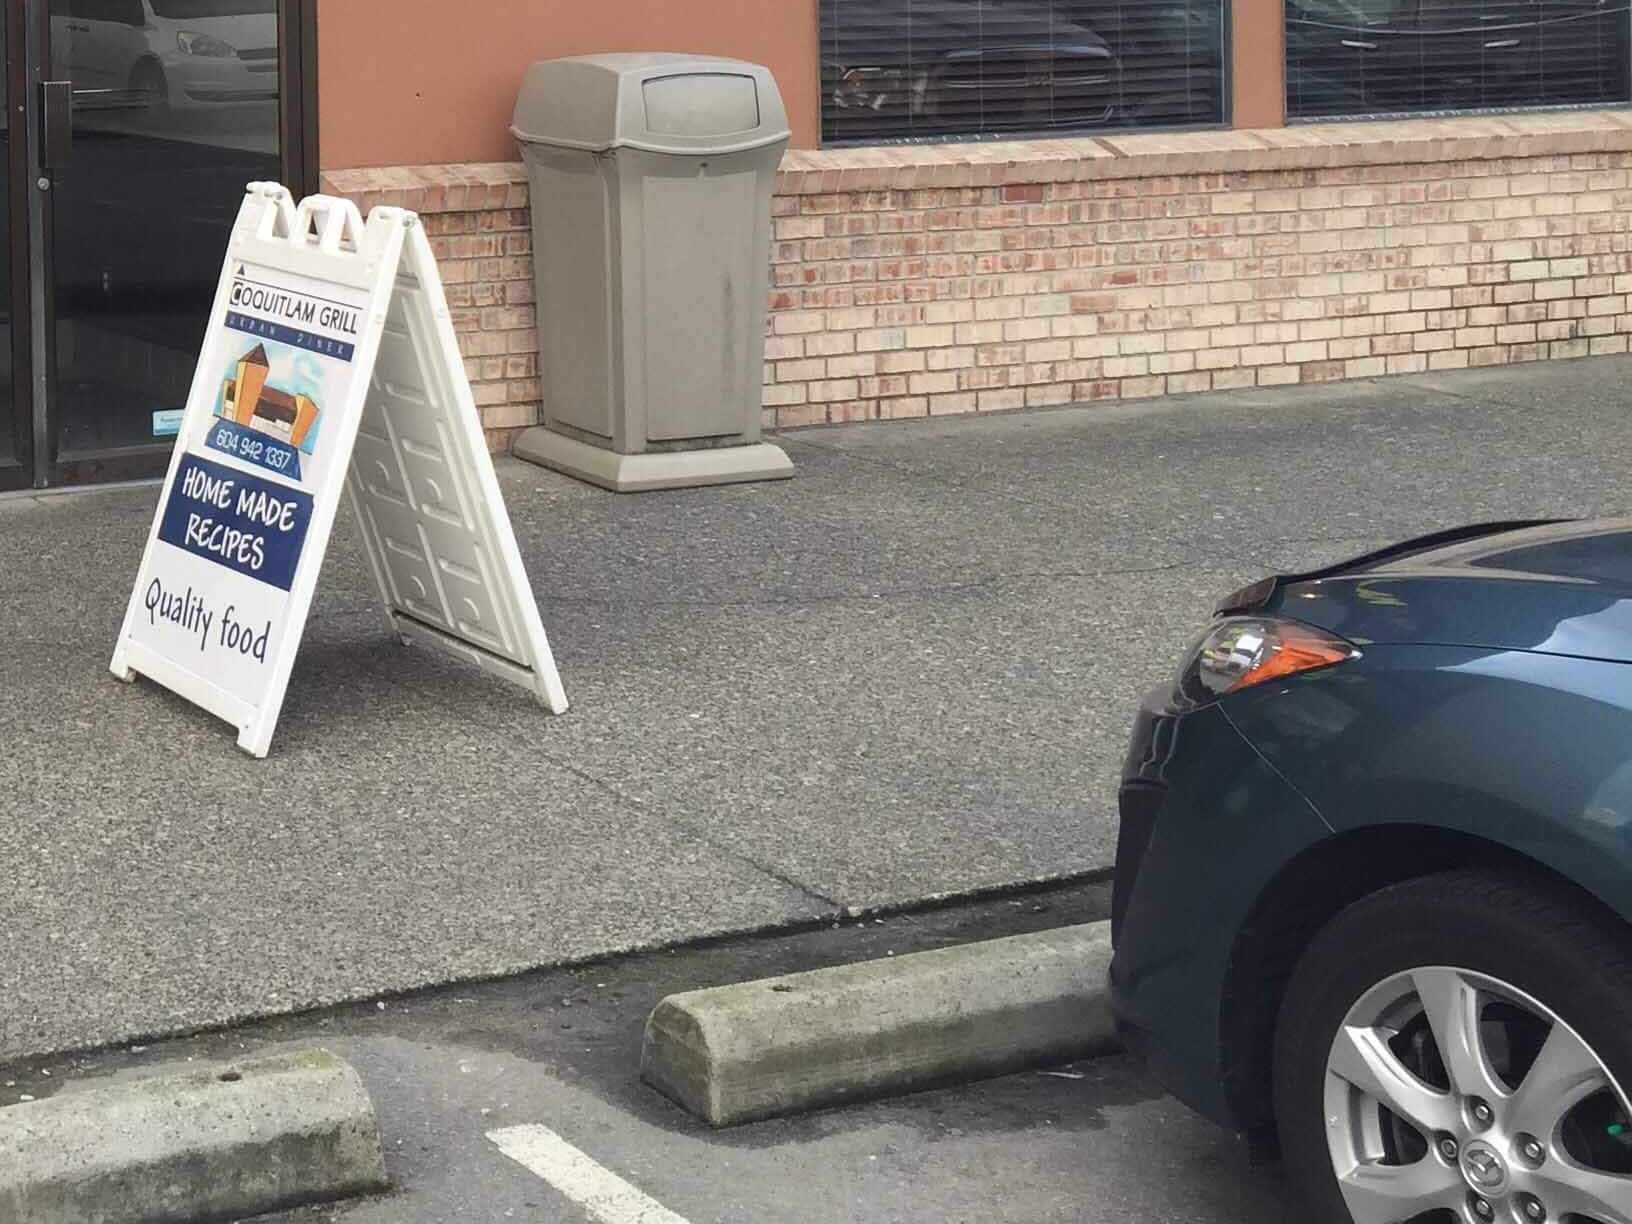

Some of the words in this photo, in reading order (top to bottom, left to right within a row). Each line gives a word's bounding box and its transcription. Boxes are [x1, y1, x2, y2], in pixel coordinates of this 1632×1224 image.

[230, 281, 316, 323] COQUITLAM
[319, 307, 357, 334] GRILL
[216, 428, 239, 450] 604
[239, 436, 263, 460] 942
[265, 445, 291, 470] 1337
[182, 466, 234, 509] HOME
[236, 488, 297, 531] MADE
[184, 513, 265, 570] RECIPES
[145, 577, 213, 652] Quality
[220, 605, 272, 664] food
